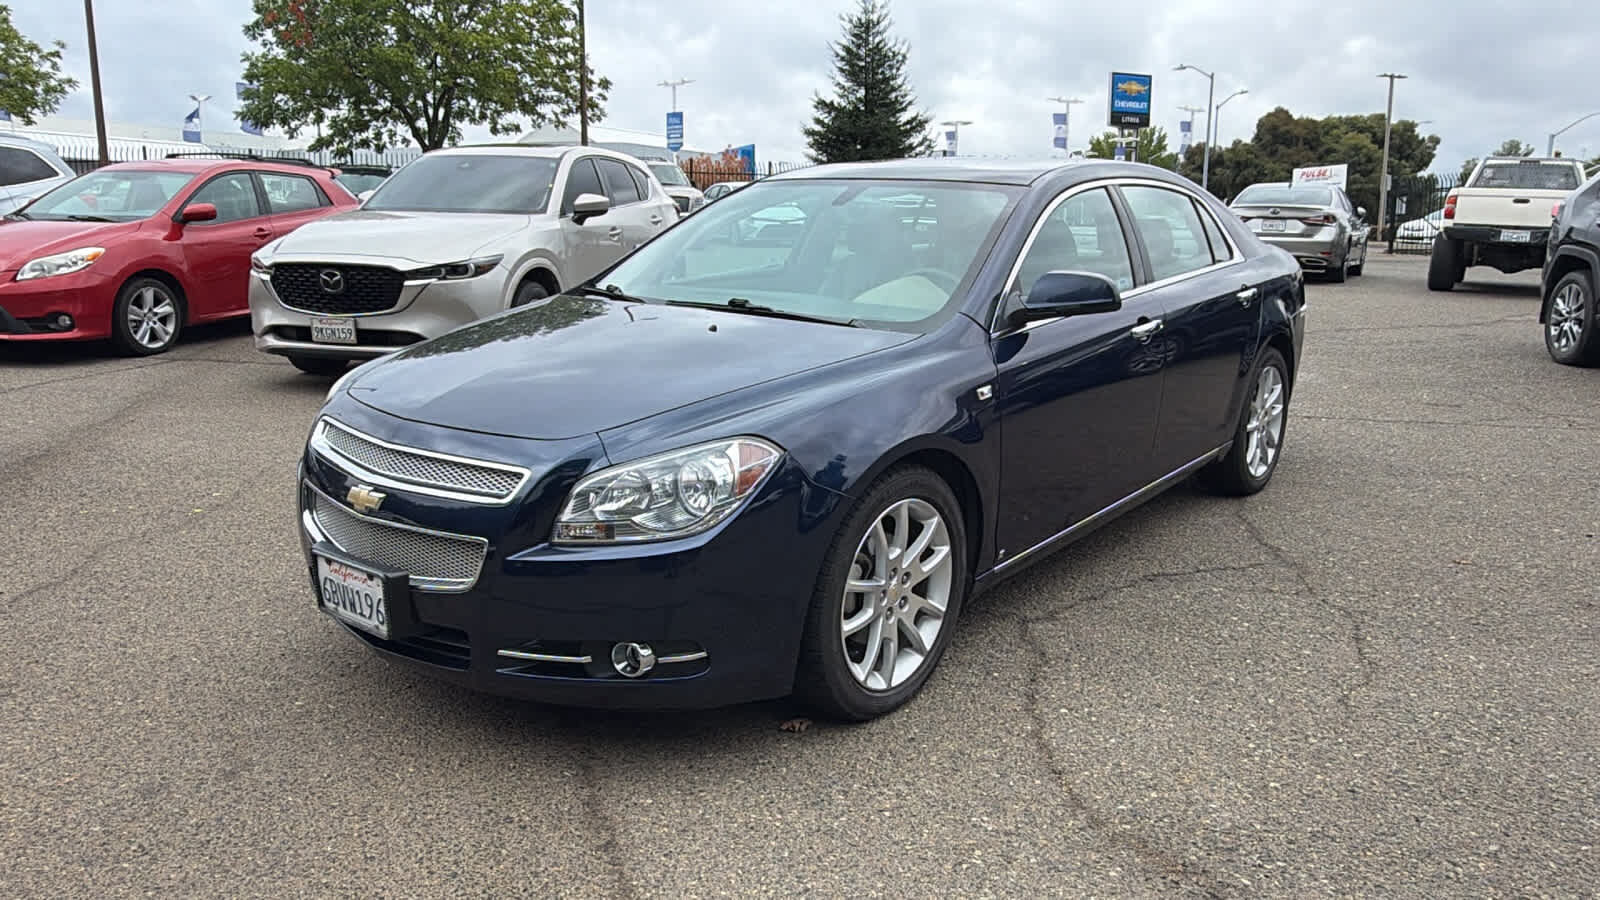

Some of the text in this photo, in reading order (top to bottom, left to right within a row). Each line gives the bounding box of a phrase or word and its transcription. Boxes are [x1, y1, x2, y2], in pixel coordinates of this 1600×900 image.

[1114, 100, 1148, 109] CHEVROLET
[1300, 168, 1328, 178] PULSE
[323, 576, 385, 626] 6BVW196
